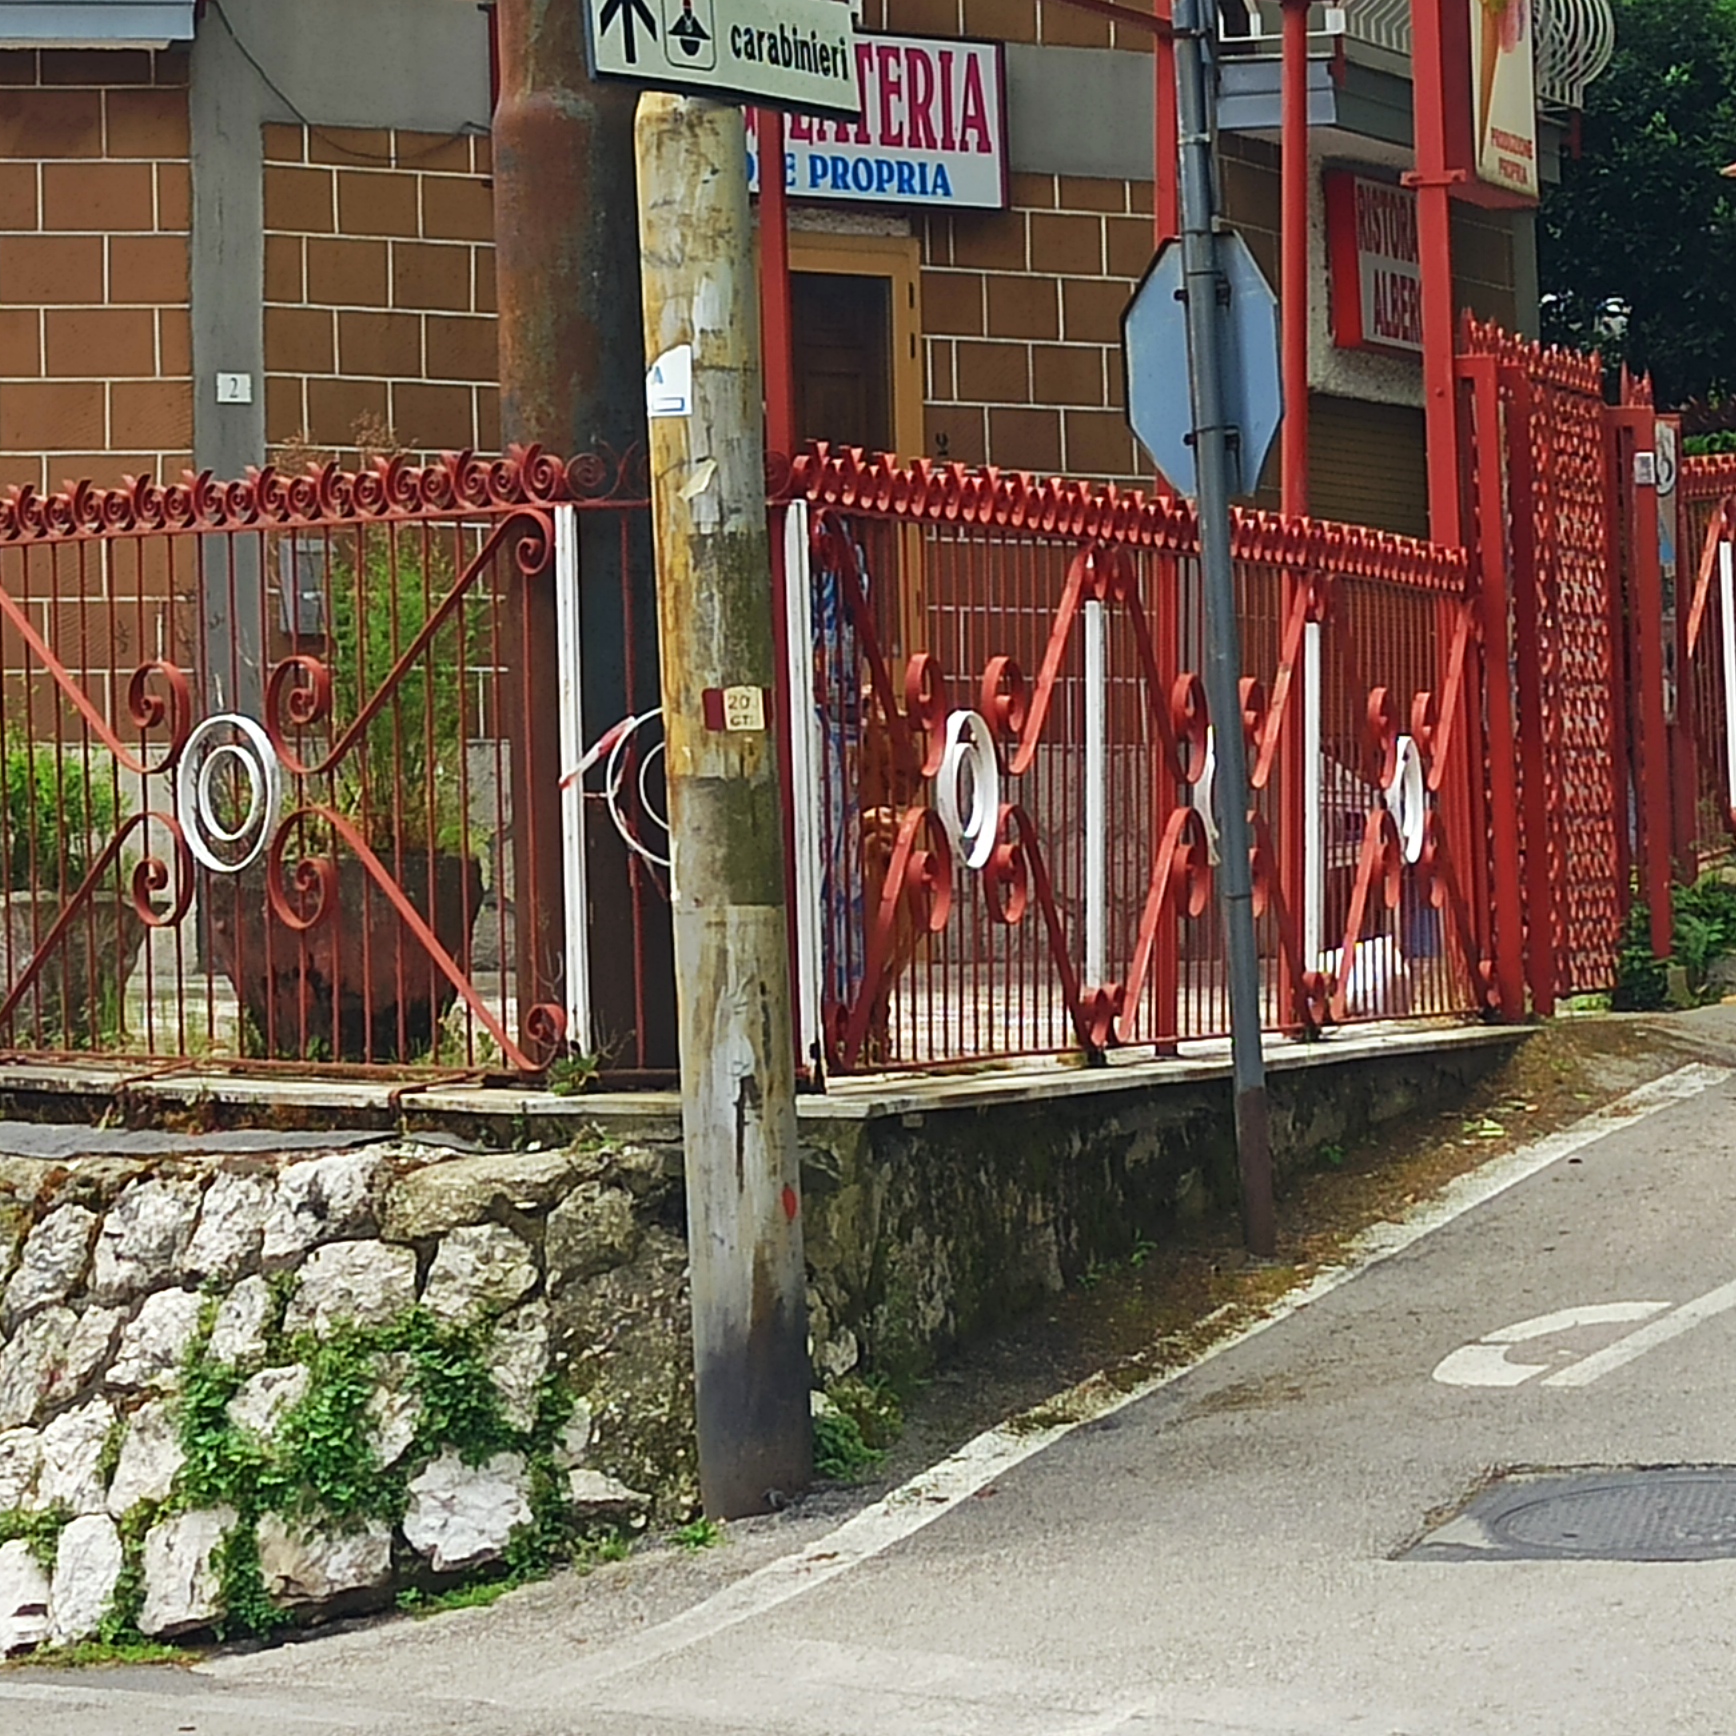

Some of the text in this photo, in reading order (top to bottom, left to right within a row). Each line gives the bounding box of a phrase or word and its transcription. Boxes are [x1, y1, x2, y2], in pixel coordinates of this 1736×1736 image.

[731, 23, 849, 80] carabinieri
[745, 41, 993, 154] TERIA
[808, 153, 953, 197] PROPRIA
[228, 377, 239, 398] 2
